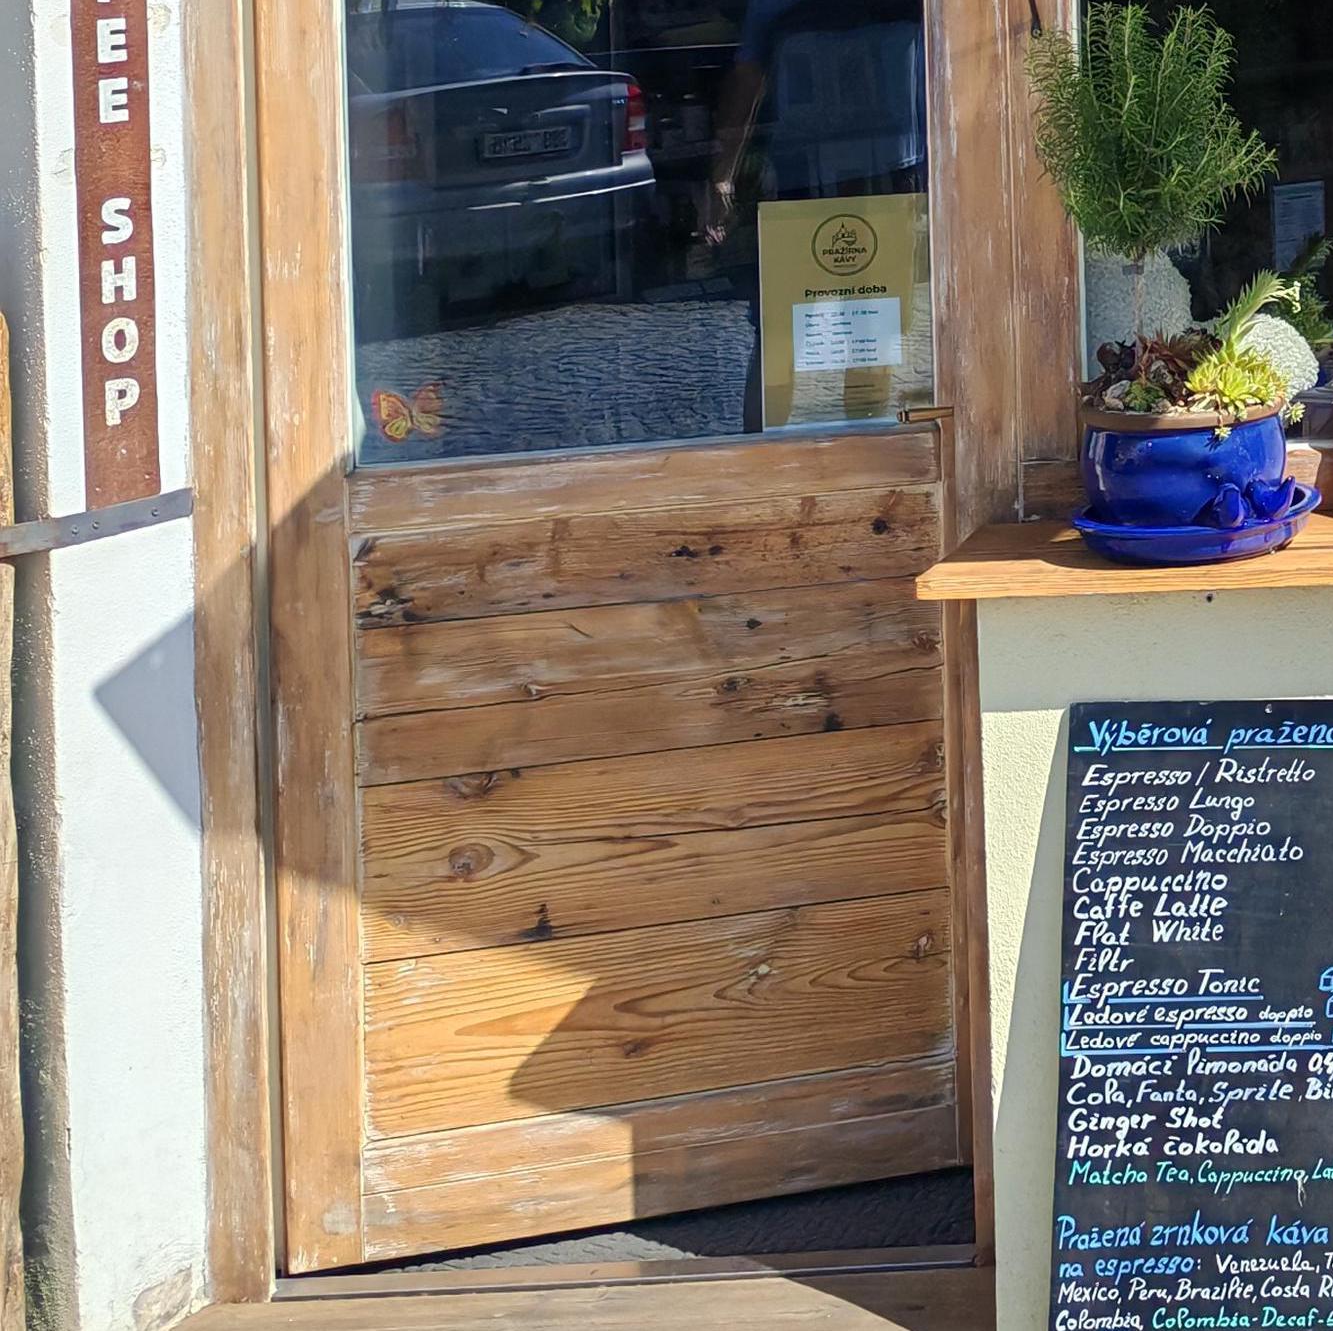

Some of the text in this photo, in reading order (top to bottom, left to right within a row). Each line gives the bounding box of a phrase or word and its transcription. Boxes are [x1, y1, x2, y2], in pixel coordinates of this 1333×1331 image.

[858, 283, 887, 295] doba
[100, 196, 140, 427] SHOP
[1081, 763, 1193, 797] Espresso
[1214, 756, 1316, 784] Ristretto
[1078, 793, 1180, 821] Espresso
[1188, 786, 1256, 821] Lungo
[1075, 817, 1175, 848] Espresso
[1183, 813, 1272, 845] Doppio
[1072, 841, 1169, 871] Espresso
[1181, 836, 1304, 864] Macchiato
[1072, 866, 1229, 902] Cappuccino
[1073, 892, 1144, 920] Caffe
[1152, 892, 1229, 918] Latte
[1073, 919, 1131, 946] Flat
[1152, 917, 1224, 943] White
[1073, 946, 1135, 972] Filtr
[1068, 972, 1190, 1008] Espresso
[1198, 969, 1261, 996] Tonic
[1066, 1003, 1150, 1027] Ledové
[1154, 1005, 1249, 1031] espresso
[1150, 1030, 1261, 1052] cappuccino
[1269, 1027, 1323, 1047] doppio
[1067, 1107, 1157, 1140] Ginger
[1165, 1105, 1225, 1130] Shot
[1066, 1134, 1153, 1159] Horká
[1067, 1159, 1148, 1186] Matcha
[1056, 1208, 1329, 1251] Pražená zrnková káva
[1059, 1260, 1084, 1279] na
[1094, 1255, 1202, 1286] espresso:
[1259, 1274, 1310, 1299] Costa
